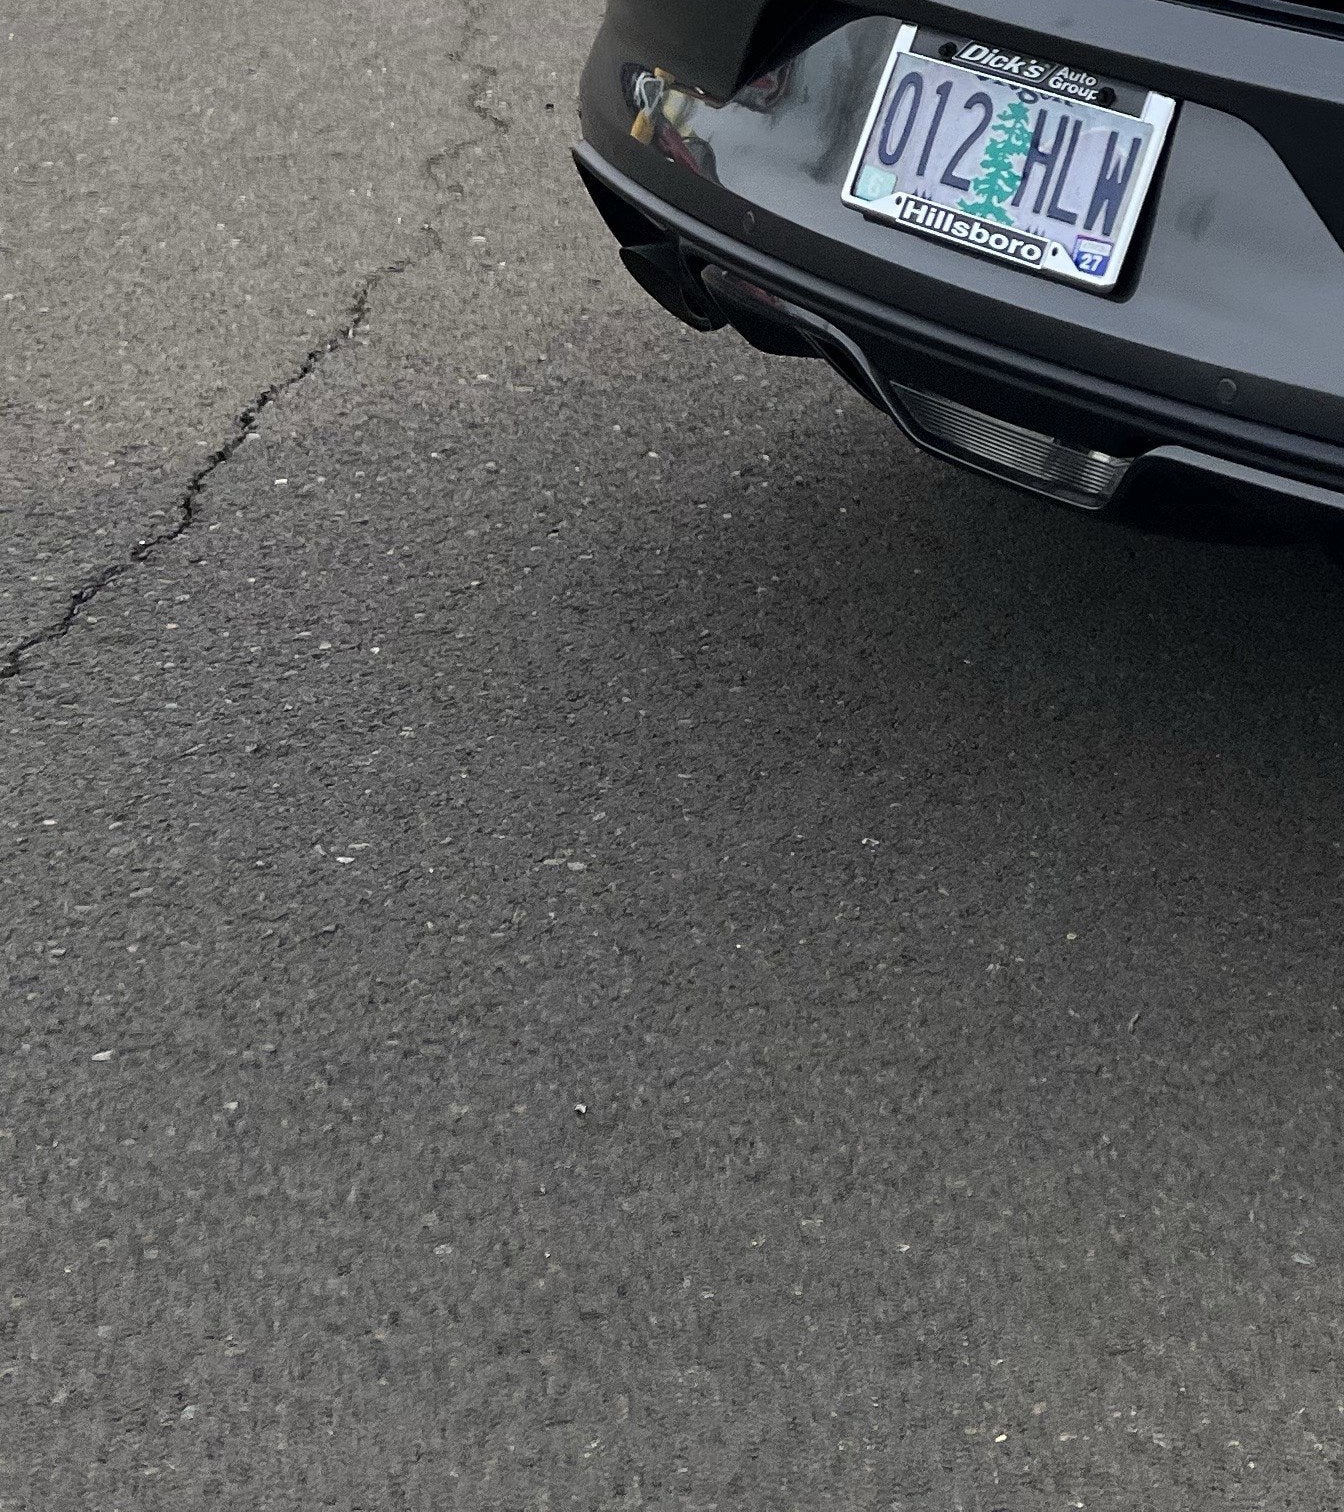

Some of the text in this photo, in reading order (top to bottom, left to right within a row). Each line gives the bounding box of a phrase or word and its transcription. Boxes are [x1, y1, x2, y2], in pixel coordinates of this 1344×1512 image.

[959, 44, 1045, 78] Dick's
[1055, 66, 1097, 87] Auto
[1011, 108, 1141, 237] HLW
[902, 200, 1043, 263] Hillsboro
[1079, 253, 1103, 272] 27
